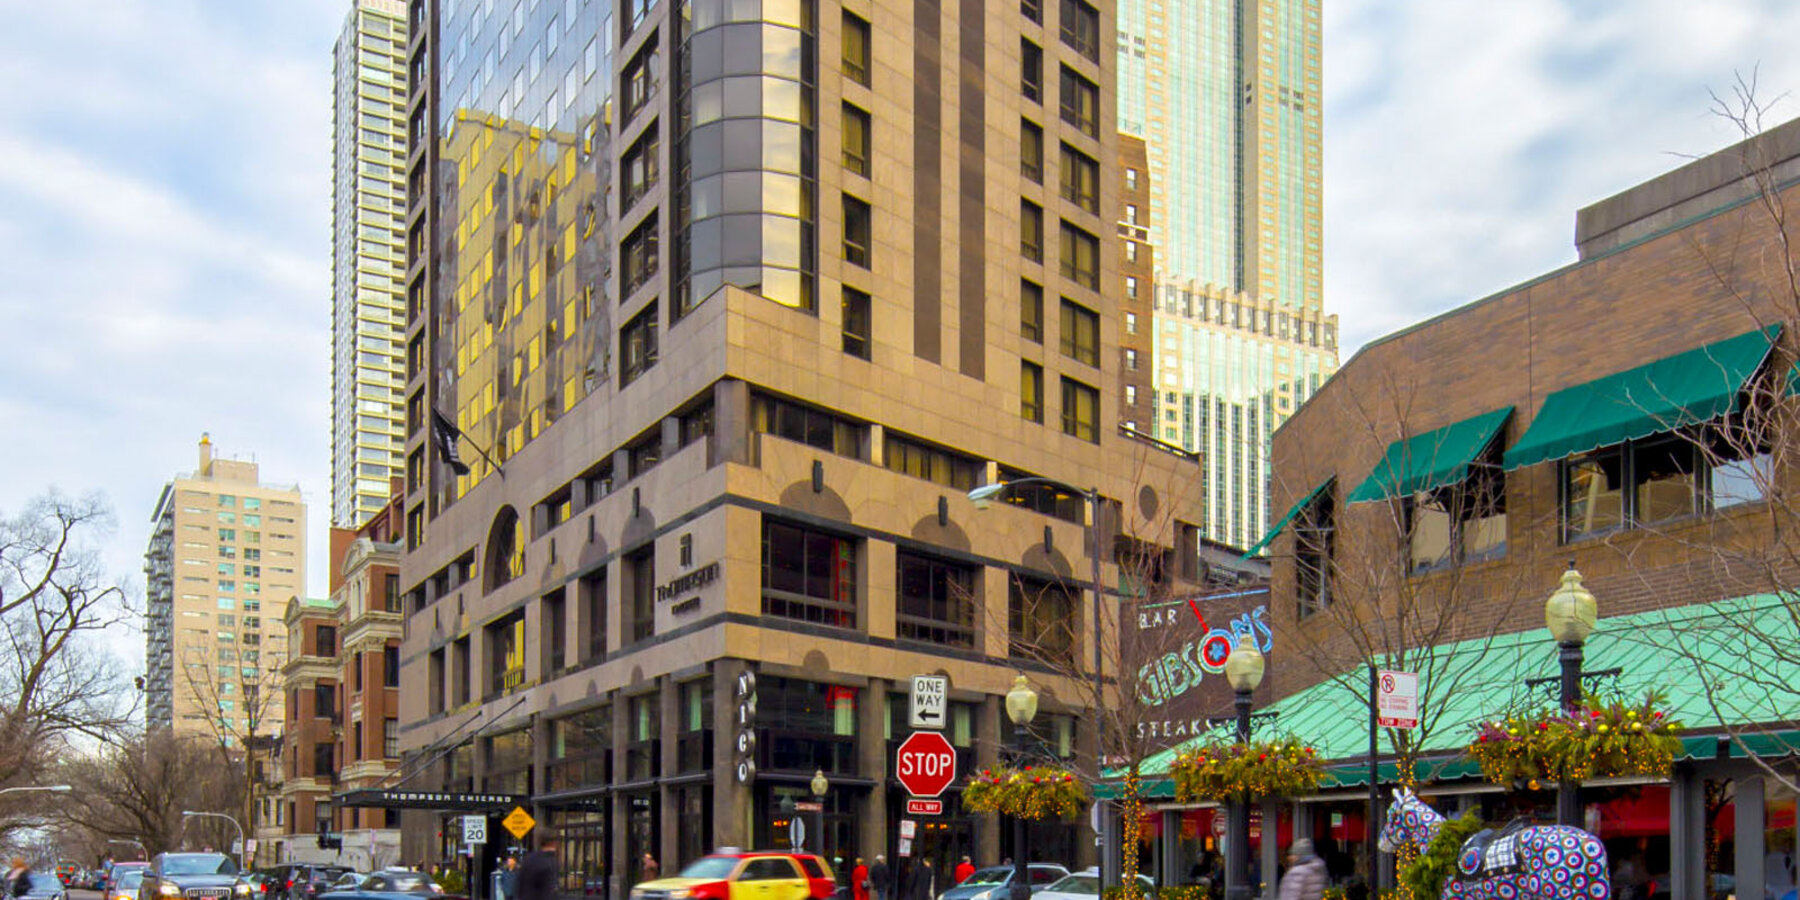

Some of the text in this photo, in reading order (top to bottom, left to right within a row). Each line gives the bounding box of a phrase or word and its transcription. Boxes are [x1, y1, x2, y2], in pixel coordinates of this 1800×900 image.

[1138, 609, 1178, 629] BAR
[1135, 605, 1273, 706] GIBSONS
[917, 679, 943, 693] ONE
[917, 694, 943, 707] WAY
[737, 672, 749, 783] NICO
[901, 752, 952, 777] STOP
[383, 792, 512, 803] THOMPSON CHICAGO
[467, 829, 484, 840] 20
